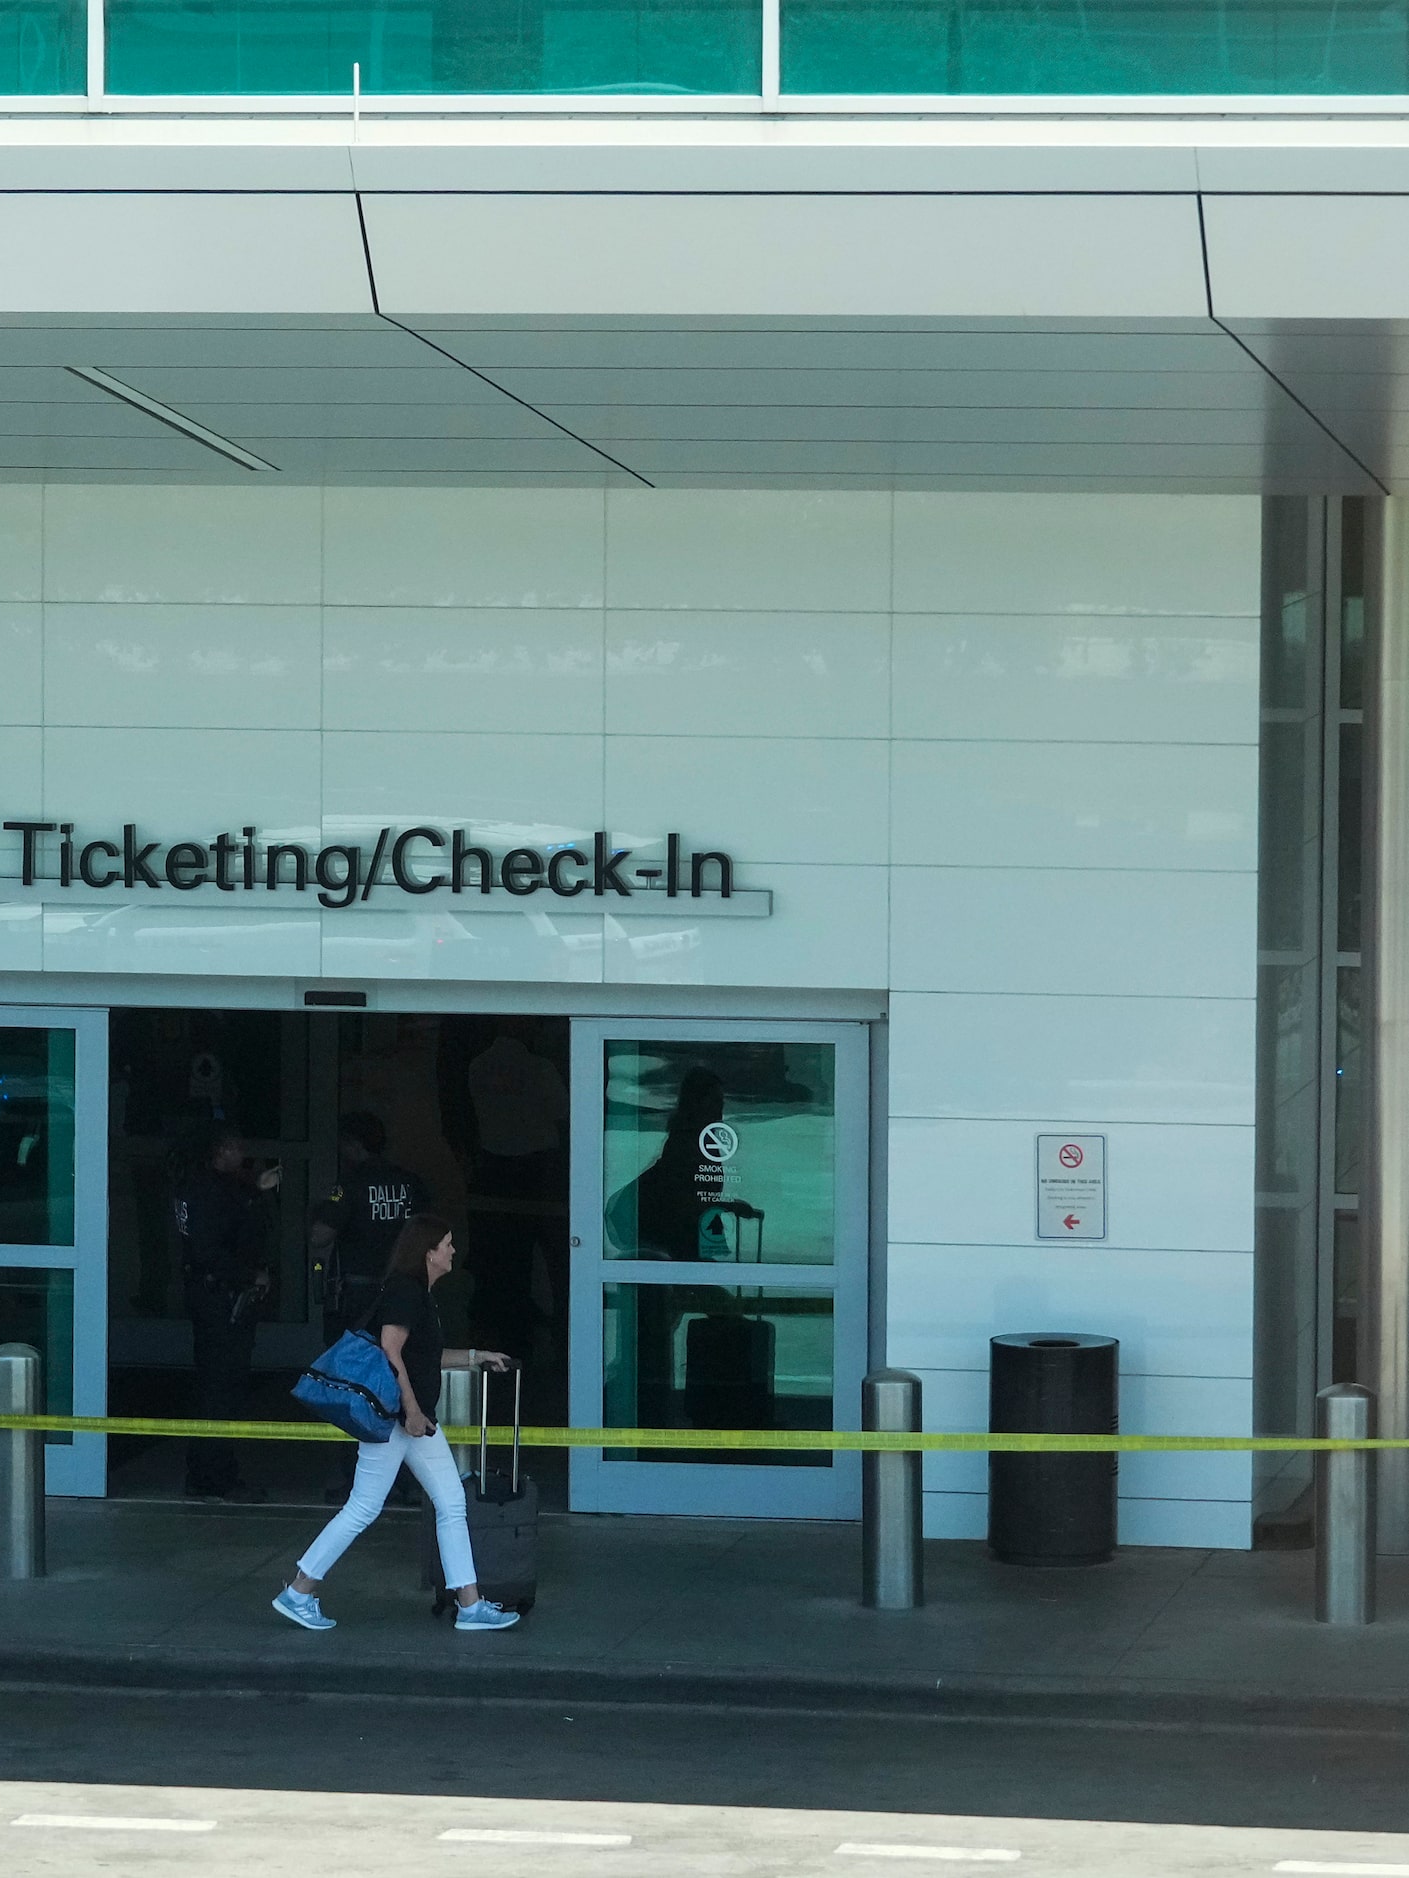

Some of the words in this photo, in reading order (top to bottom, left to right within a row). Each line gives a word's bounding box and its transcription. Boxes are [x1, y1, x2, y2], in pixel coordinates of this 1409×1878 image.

[3, 821, 733, 908] Ticketing/Check-In
[698, 1164, 737, 1174] SMOKING
[694, 1174, 742, 1183] PROHIBITED
